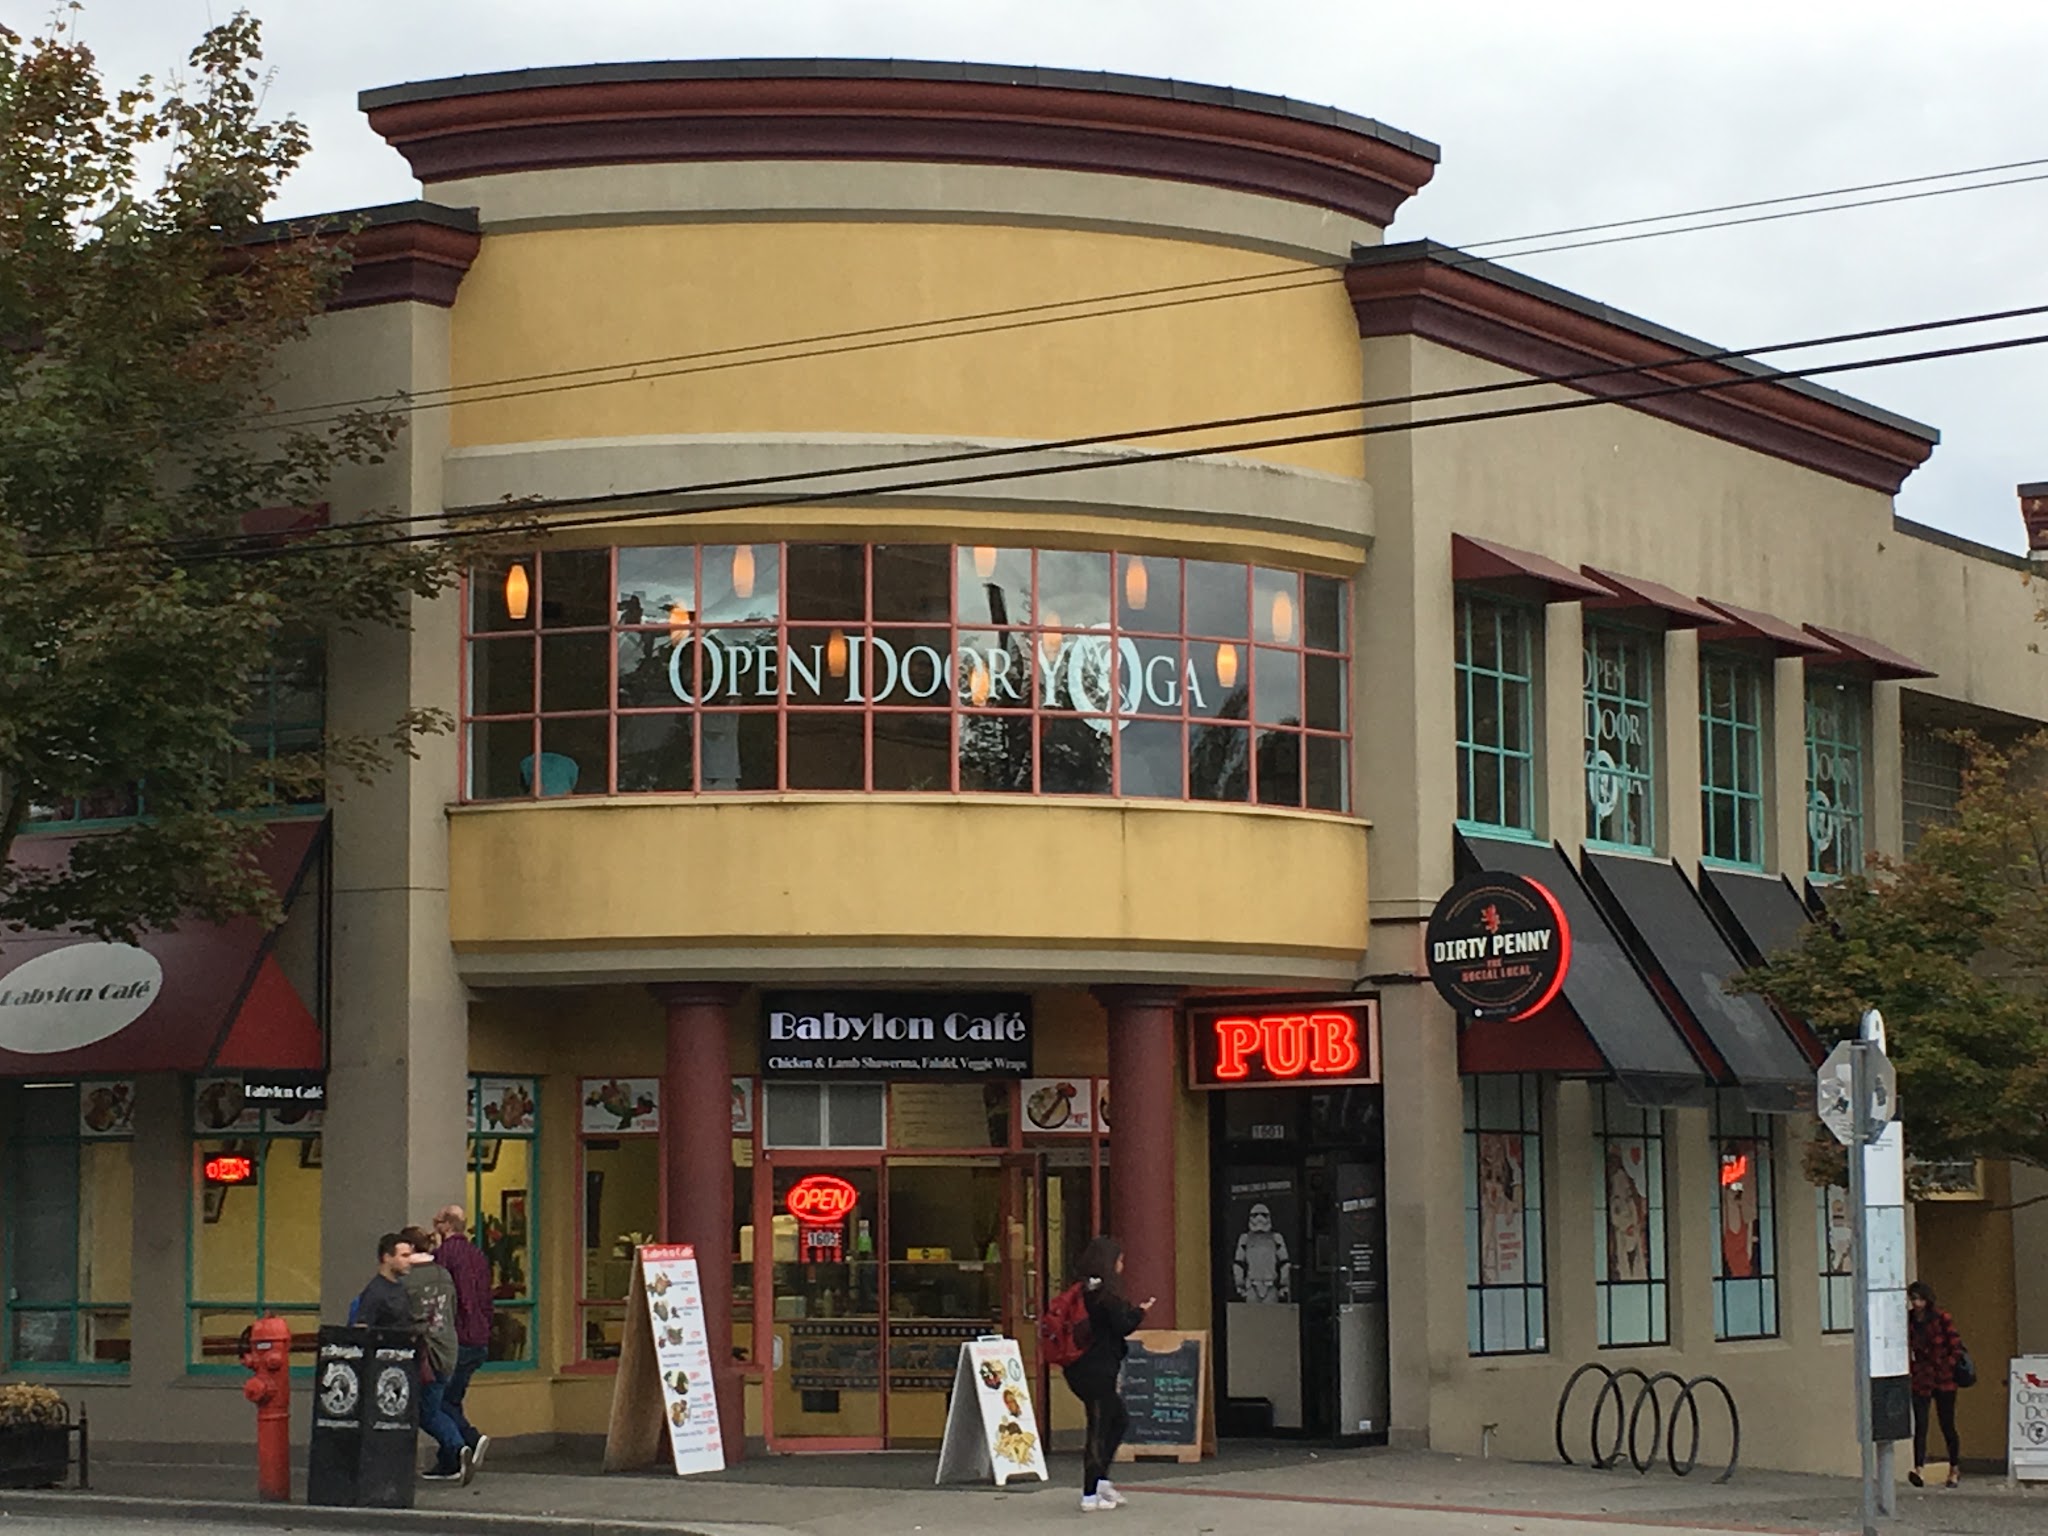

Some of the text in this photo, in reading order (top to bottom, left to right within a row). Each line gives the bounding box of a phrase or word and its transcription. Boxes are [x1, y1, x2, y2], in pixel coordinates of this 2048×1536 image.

[669, 622, 1207, 735] OPEN DOOR YOGA
[1434, 929, 1551, 963] DIRTY PENNY
[1462, 964, 1532, 983] SOCIAL LOCAL
[98, 979, 150, 1001] Café
[769, 1011, 1026, 1042] Babylon Café
[1216, 1014, 1358, 1077] PUB
[768, 1056, 813, 1070] Chicken
[814, 1057, 825, 1069] &
[828, 1056, 861, 1070] Lamb
[960, 1056, 993, 1073] Veggie
[994, 1057, 1027, 1073] Wraps
[206, 1160, 251, 1178] OPEN
[792, 1188, 850, 1211] OPEN
